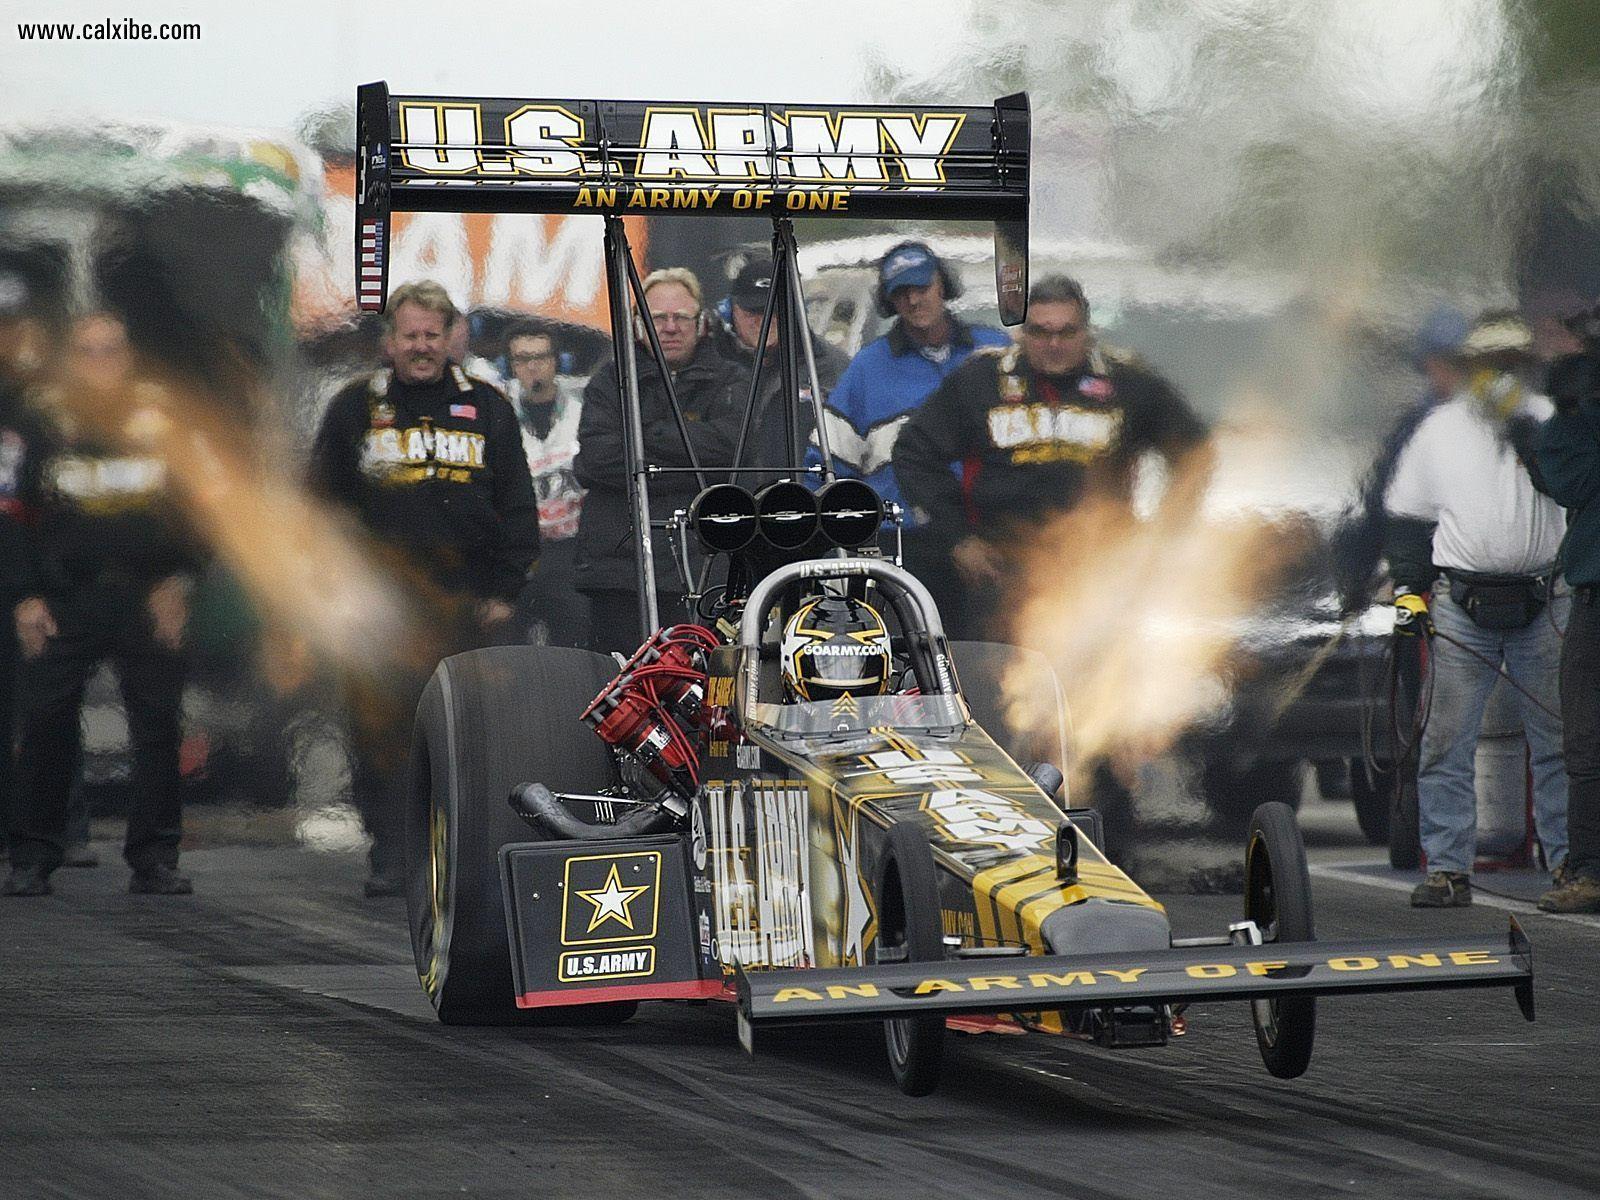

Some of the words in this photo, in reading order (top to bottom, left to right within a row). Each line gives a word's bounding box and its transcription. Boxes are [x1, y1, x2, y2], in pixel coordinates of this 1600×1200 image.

[399, 101, 623, 176] U.S.
[635, 107, 967, 183] ARMY
[573, 188, 616, 207] AN
[628, 189, 720, 209] ARMY
[732, 190, 775, 210] OF
[786, 191, 851, 211] ONE
[803, 645, 885, 657] GOARMY.COM
[772, 983, 880, 1003] AN
[914, 968, 1148, 994] ARMY
[1185, 960, 1289, 979] OF
[1327, 950, 1500, 972] ONE
